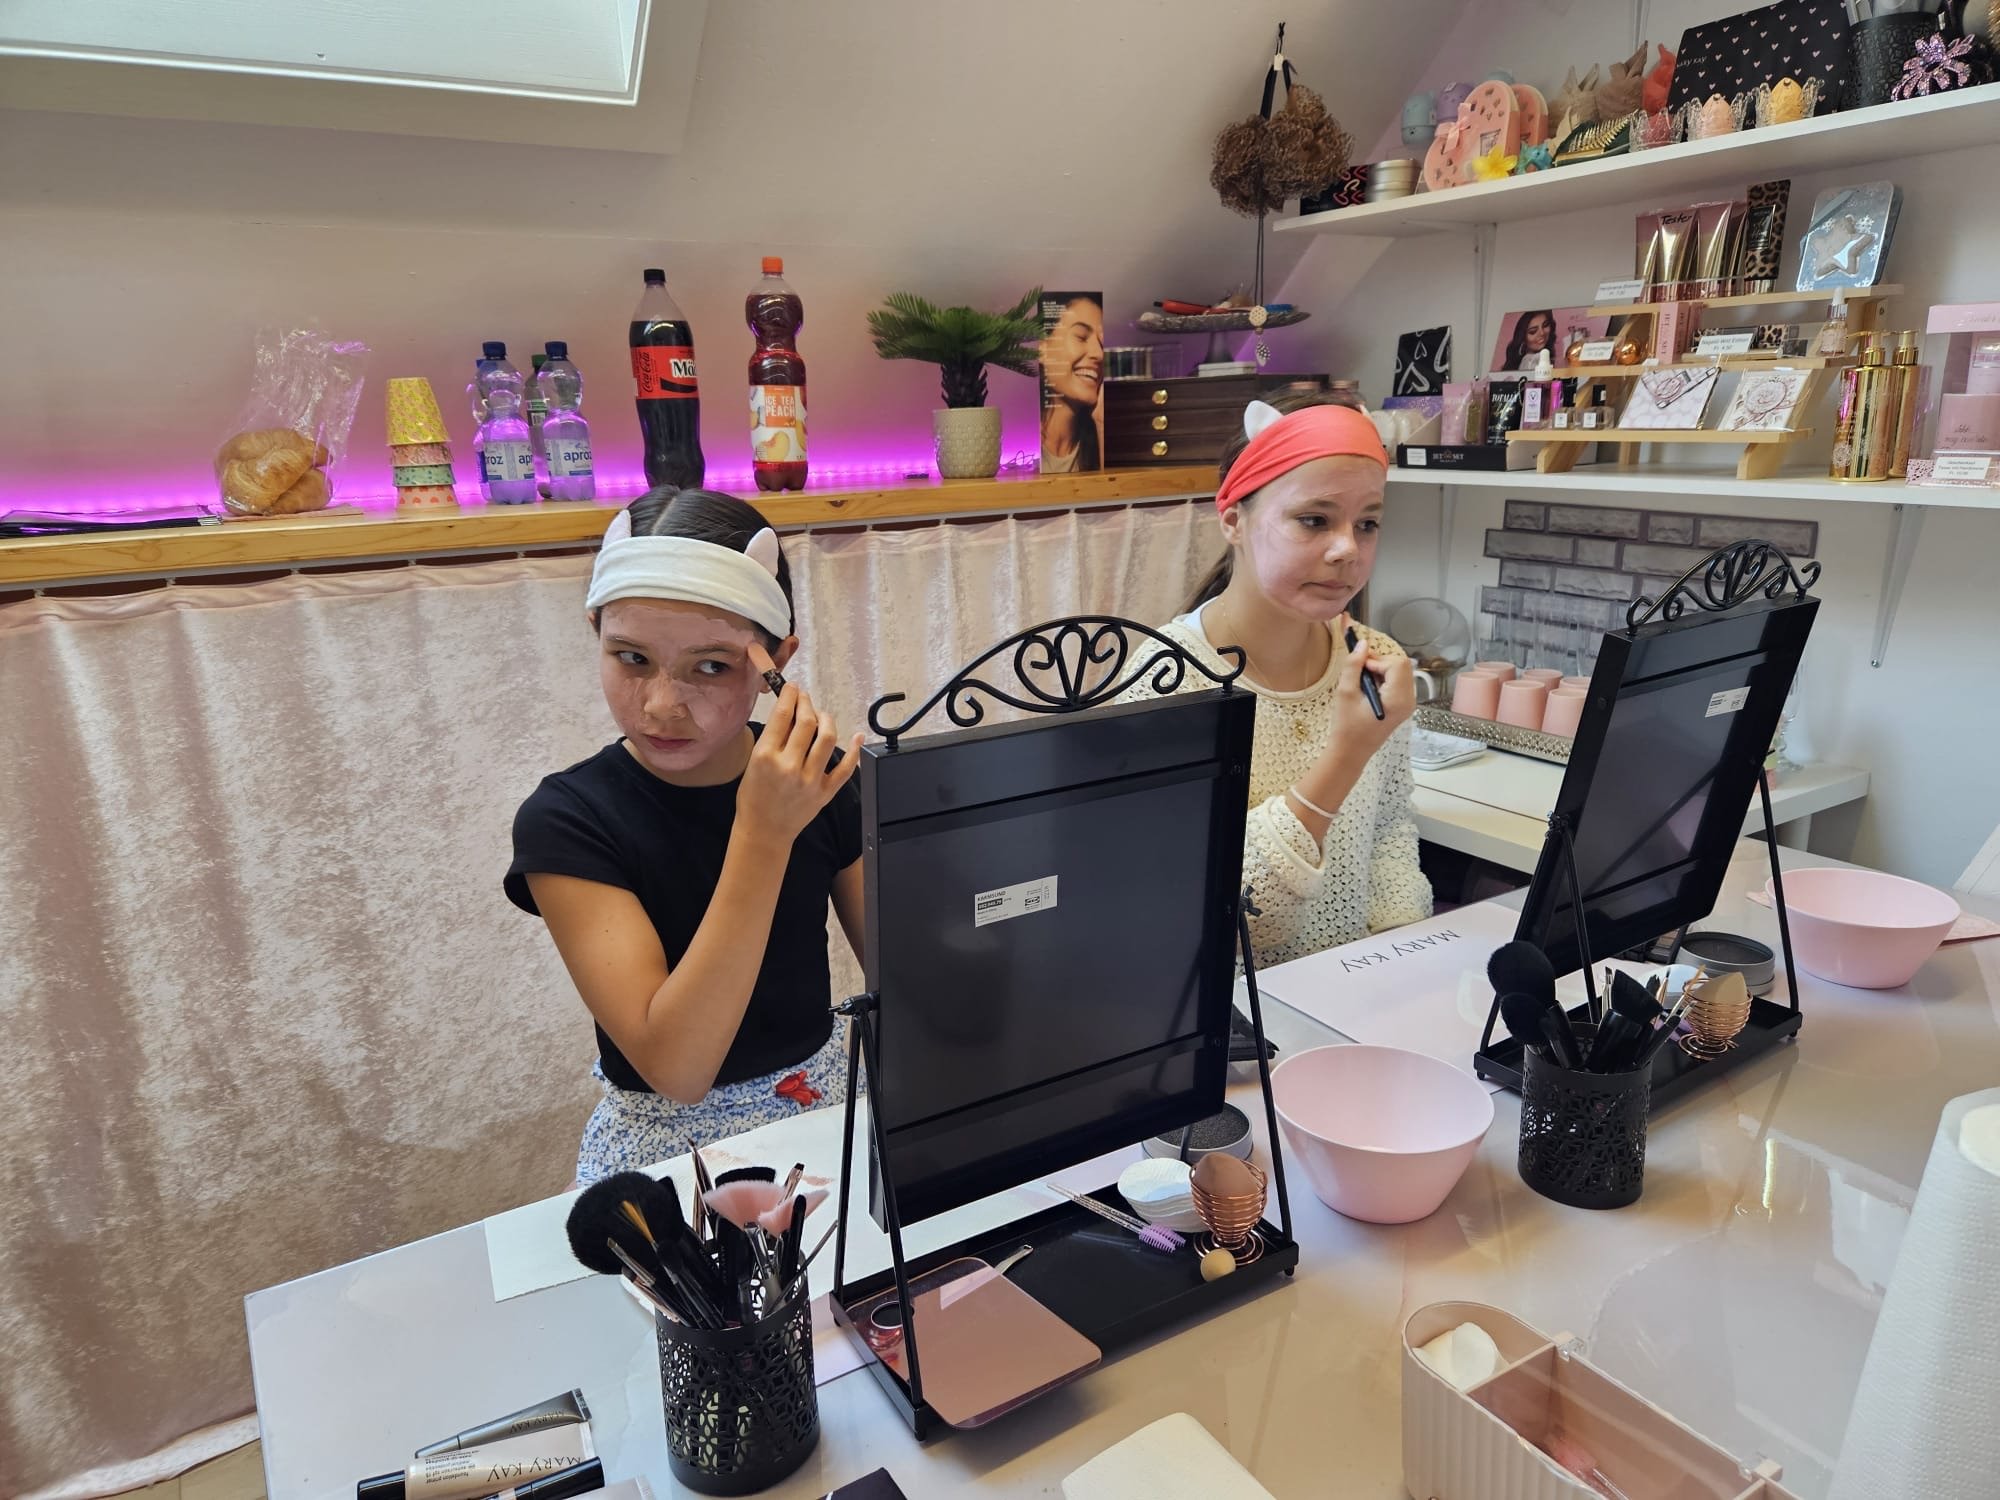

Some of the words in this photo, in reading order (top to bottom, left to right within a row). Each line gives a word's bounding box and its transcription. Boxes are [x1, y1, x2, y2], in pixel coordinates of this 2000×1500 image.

[1661, 212, 1692, 225] Tester
[766, 396, 777, 406] ICE
[782, 396, 795, 406] TEA
[766, 405, 795, 417] PEACH
[1392, 929, 1461, 956] MARY
[1340, 952, 1390, 973] KAY
[510, 1420, 532, 1433] KAY
[529, 1456, 581, 1474] MARY
[487, 1465, 522, 1482] KAY
